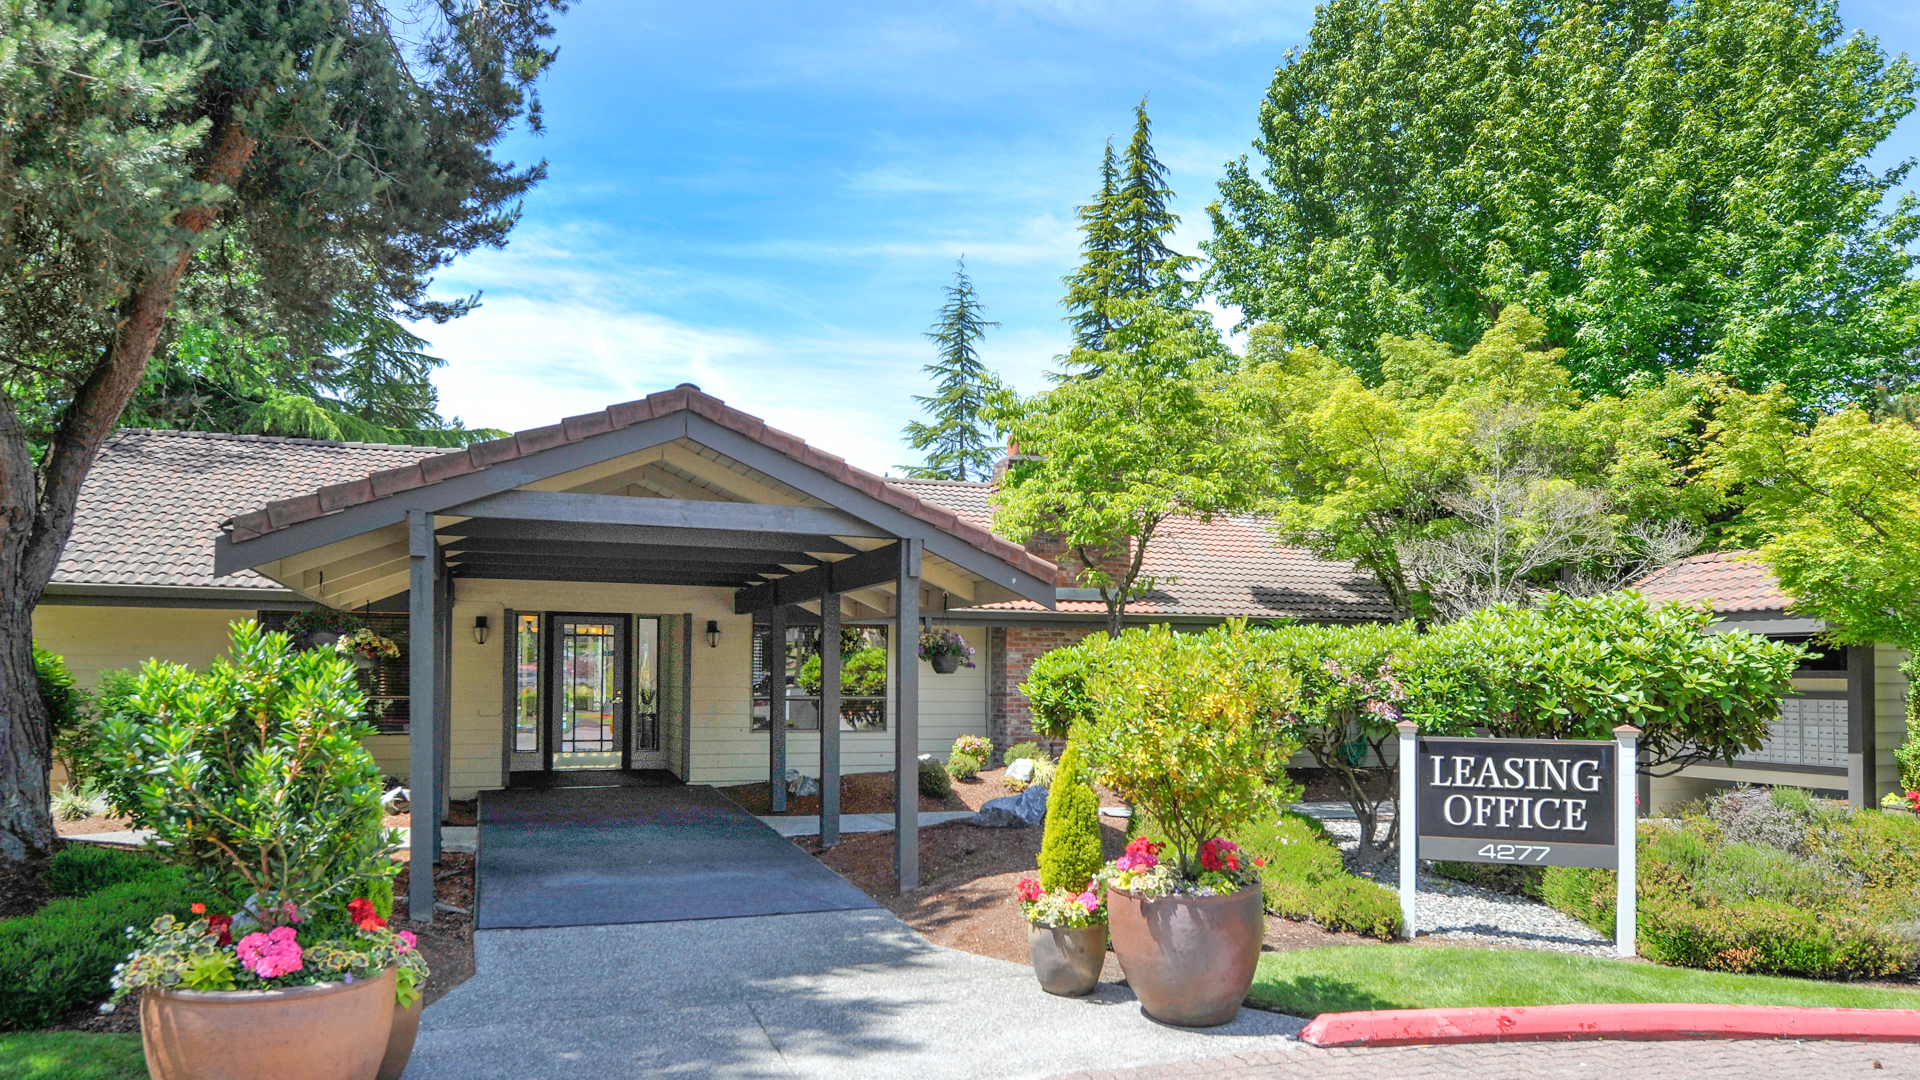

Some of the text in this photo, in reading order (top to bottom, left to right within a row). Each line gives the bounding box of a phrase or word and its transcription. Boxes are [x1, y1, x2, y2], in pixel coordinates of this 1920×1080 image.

[1430, 755, 1602, 792] LEASING
[1444, 794, 1587, 831] OFFICE
[1478, 843, 1550, 862] 4277
